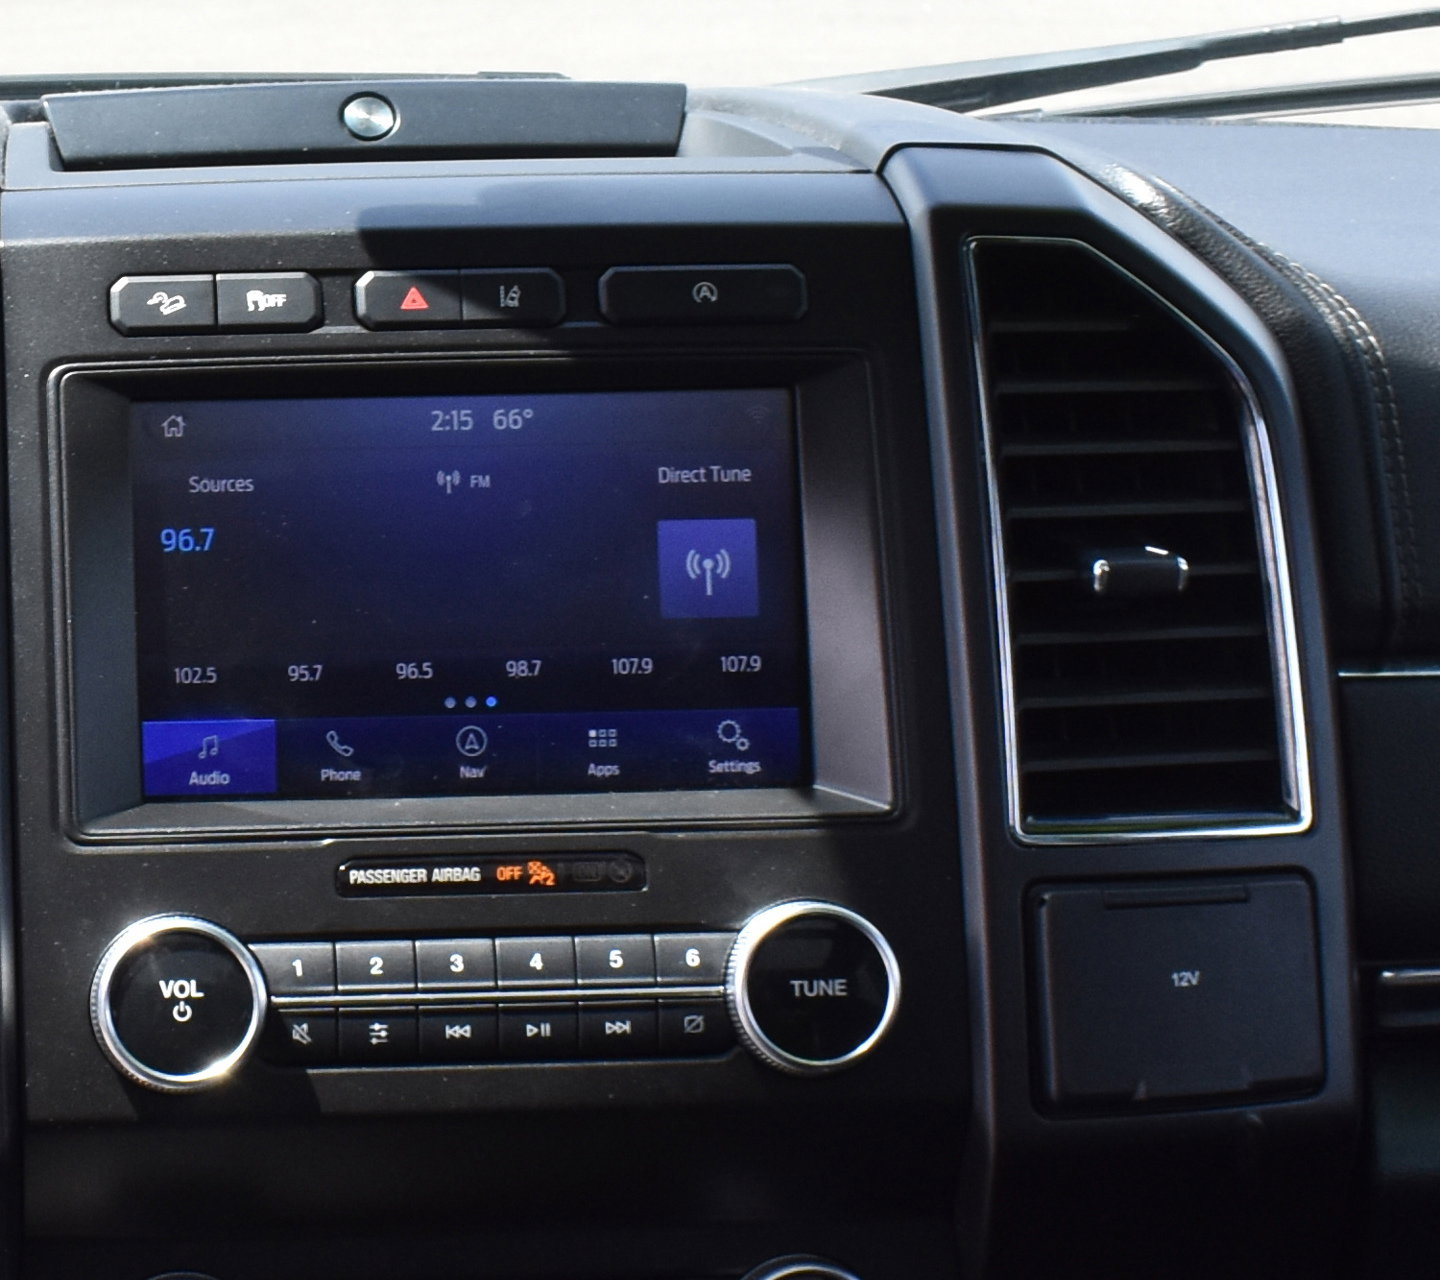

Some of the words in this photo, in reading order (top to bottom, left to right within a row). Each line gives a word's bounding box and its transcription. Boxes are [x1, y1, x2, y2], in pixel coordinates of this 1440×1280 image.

[431, 410, 473, 432] 2:15
[470, 474, 491, 489] FM
[658, 464, 705, 485] Direct
[710, 465, 752, 484] Tune
[189, 474, 254, 495] Sources
[160, 528, 215, 554] 96.7
[287, 664, 323, 683] 95.7
[396, 662, 433, 681] 96.5
[506, 660, 542, 679] 98.7
[611, 657, 653, 677] 107.9
[720, 655, 762, 674] 107.9
[173, 666, 217, 685] 102.5
[321, 767, 361, 783] Phone
[459, 765, 486, 779] Nav
[587, 762, 620, 781] Apps
[708, 758, 761, 776] Settings
[189, 770, 230, 786] Audio
[349, 865, 428, 887] PASSENGER
[431, 864, 481, 885] AIRBAG
[497, 863, 524, 883] OFF
[369, 957, 384, 975] 2
[449, 954, 464, 973] 3
[529, 953, 544, 971] 4
[609, 951, 624, 969] 5
[685, 948, 701, 967] 6
[292, 959, 304, 977] 1
[790, 977, 848, 998] TUNE
[1171, 971, 1201, 987] 12V
[159, 980, 204, 1000] VOL
